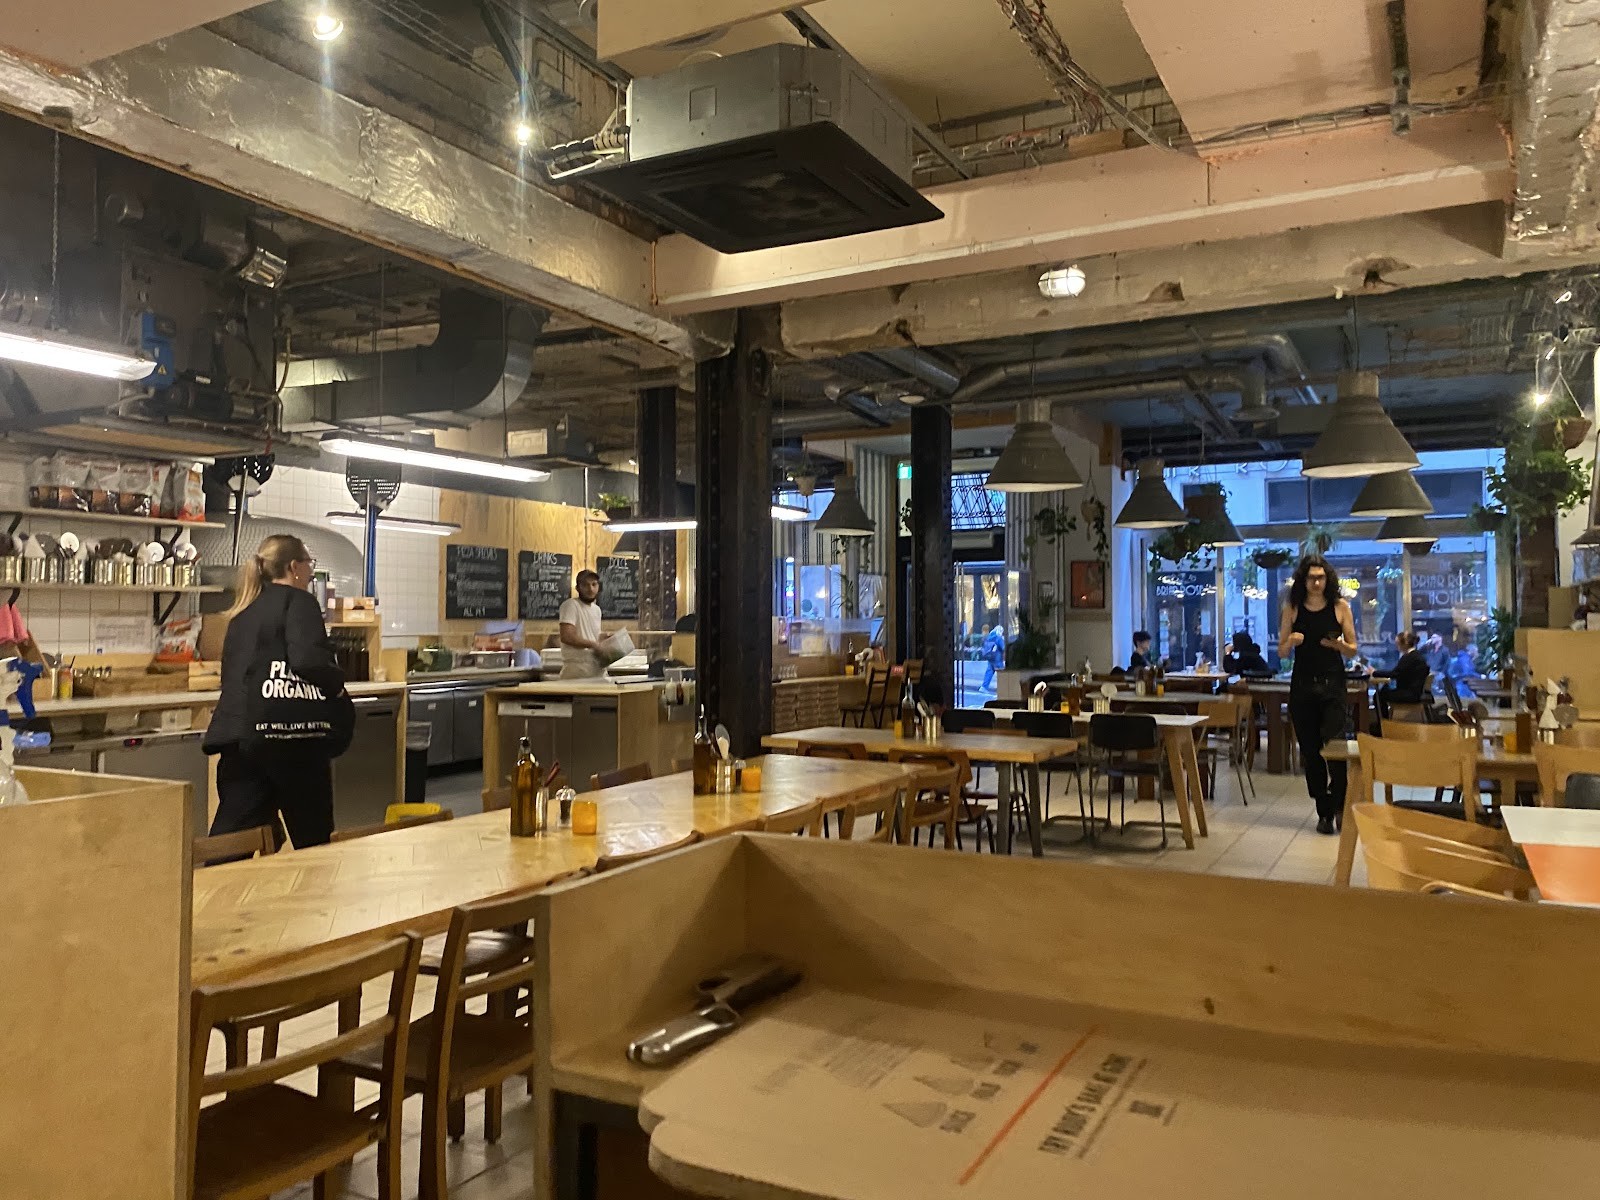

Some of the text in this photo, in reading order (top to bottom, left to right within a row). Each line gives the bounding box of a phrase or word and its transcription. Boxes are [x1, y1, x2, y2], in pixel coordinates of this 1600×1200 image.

[533, 552, 558, 565] DRINKS
[1411, 572, 1481, 589] BRIAR ROSE
[261, 679, 327, 701] ORGANIC
[255, 723, 269, 731] EAT
